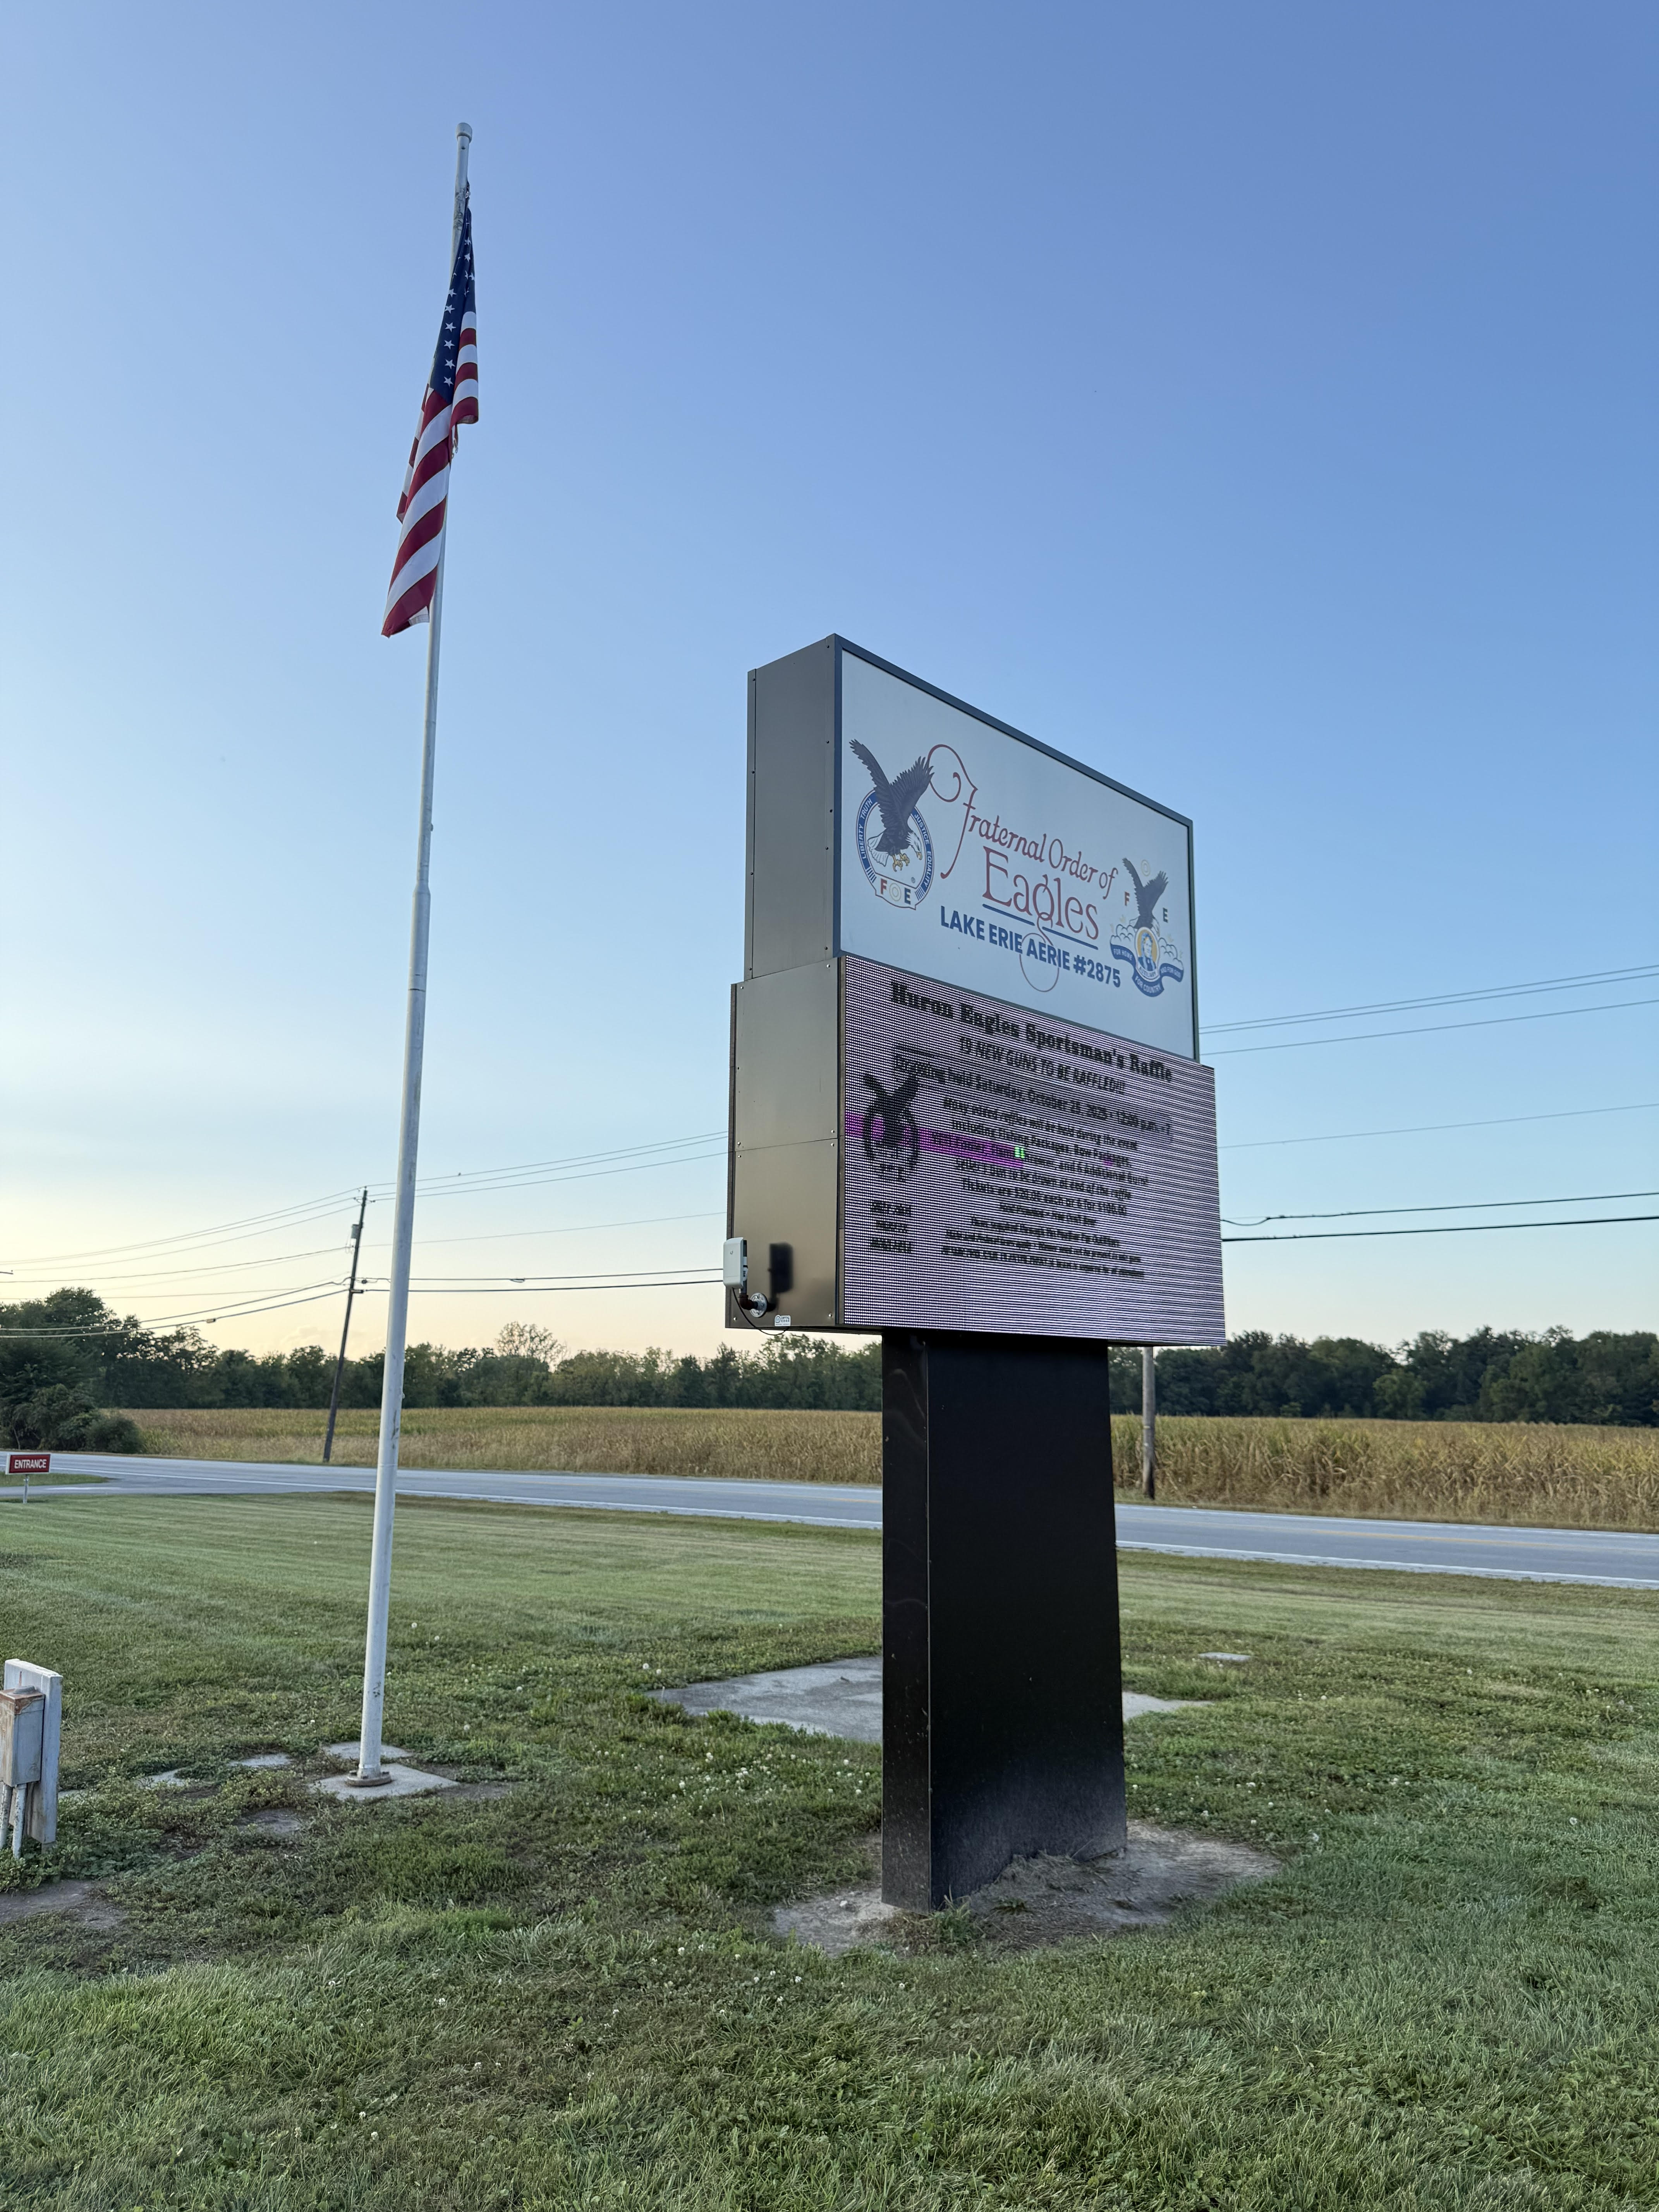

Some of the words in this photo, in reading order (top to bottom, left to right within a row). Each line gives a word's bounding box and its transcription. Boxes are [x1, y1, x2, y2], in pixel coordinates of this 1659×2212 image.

[860, 798, 872, 820] TRUTH
[927, 744, 1046, 879] Fraternal
[1049, 839, 1098, 883] Order
[1099, 867, 1118, 900] of
[858, 824, 866, 860] LIBERTY
[914, 814, 929, 845] JUSTICE
[982, 846, 1099, 992] Eagles
[941, 905, 985, 940] LAKE
[989, 924, 1023, 953] ERIE
[1026, 938, 1070, 970] AERIE
[1073, 955, 1121, 988] #2875
[891, 981, 953, 1019] Huron
[960, 1002, 1019, 1043] Eagles
[1026, 1022, 1124, 1073] Sportsman's
[1129, 1053, 1171, 1083] Raffle
[975, 1040, 1002, 1063] NEW
[1005, 1048, 1036, 1072] GUNS
[1041, 1058, 1054, 1077] TO
[1057, 1063, 1070, 1081] BE
[1027, 1087, 1067, 1111] October
[14, 1459, 47, 1469] ENTRANCE
